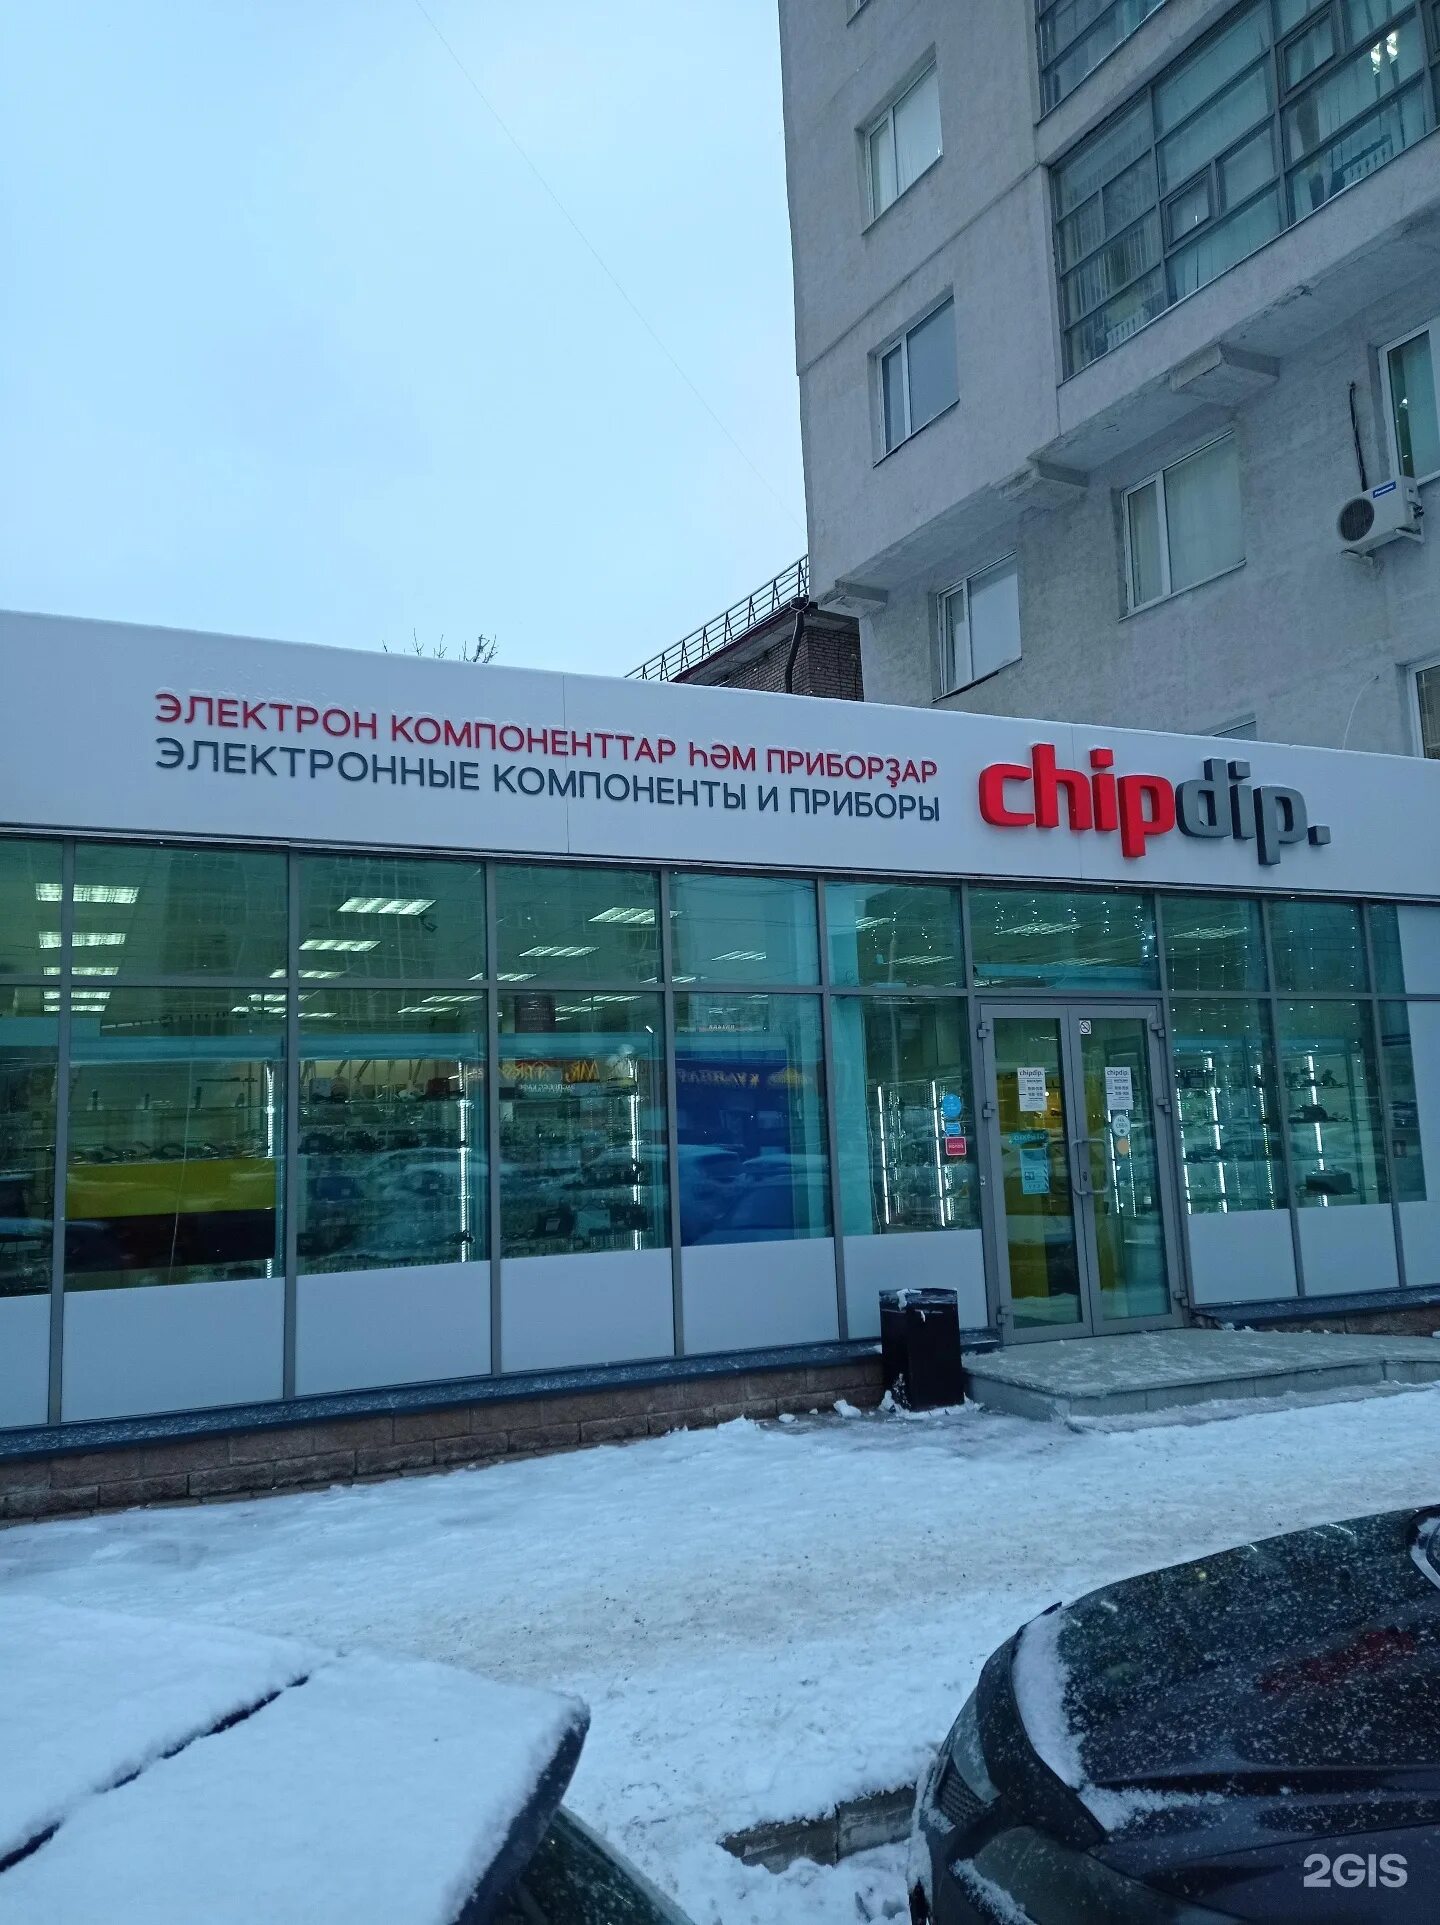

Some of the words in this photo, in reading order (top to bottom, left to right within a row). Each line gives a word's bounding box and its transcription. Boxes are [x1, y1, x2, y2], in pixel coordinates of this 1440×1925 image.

[155, 693, 377, 739] ЭЛЕКТРОН
[391, 714, 677, 764] КОМПОНЕНТТАР
[767, 749, 938, 787] ПРИБОРҘАР
[155, 737, 480, 790] ЭЛЕКТРОННЫЕ
[494, 764, 746, 810] КОМПОНЕНТЫ
[758, 786, 779, 812] И
[790, 788, 940, 822] ПРИБОРЫ
